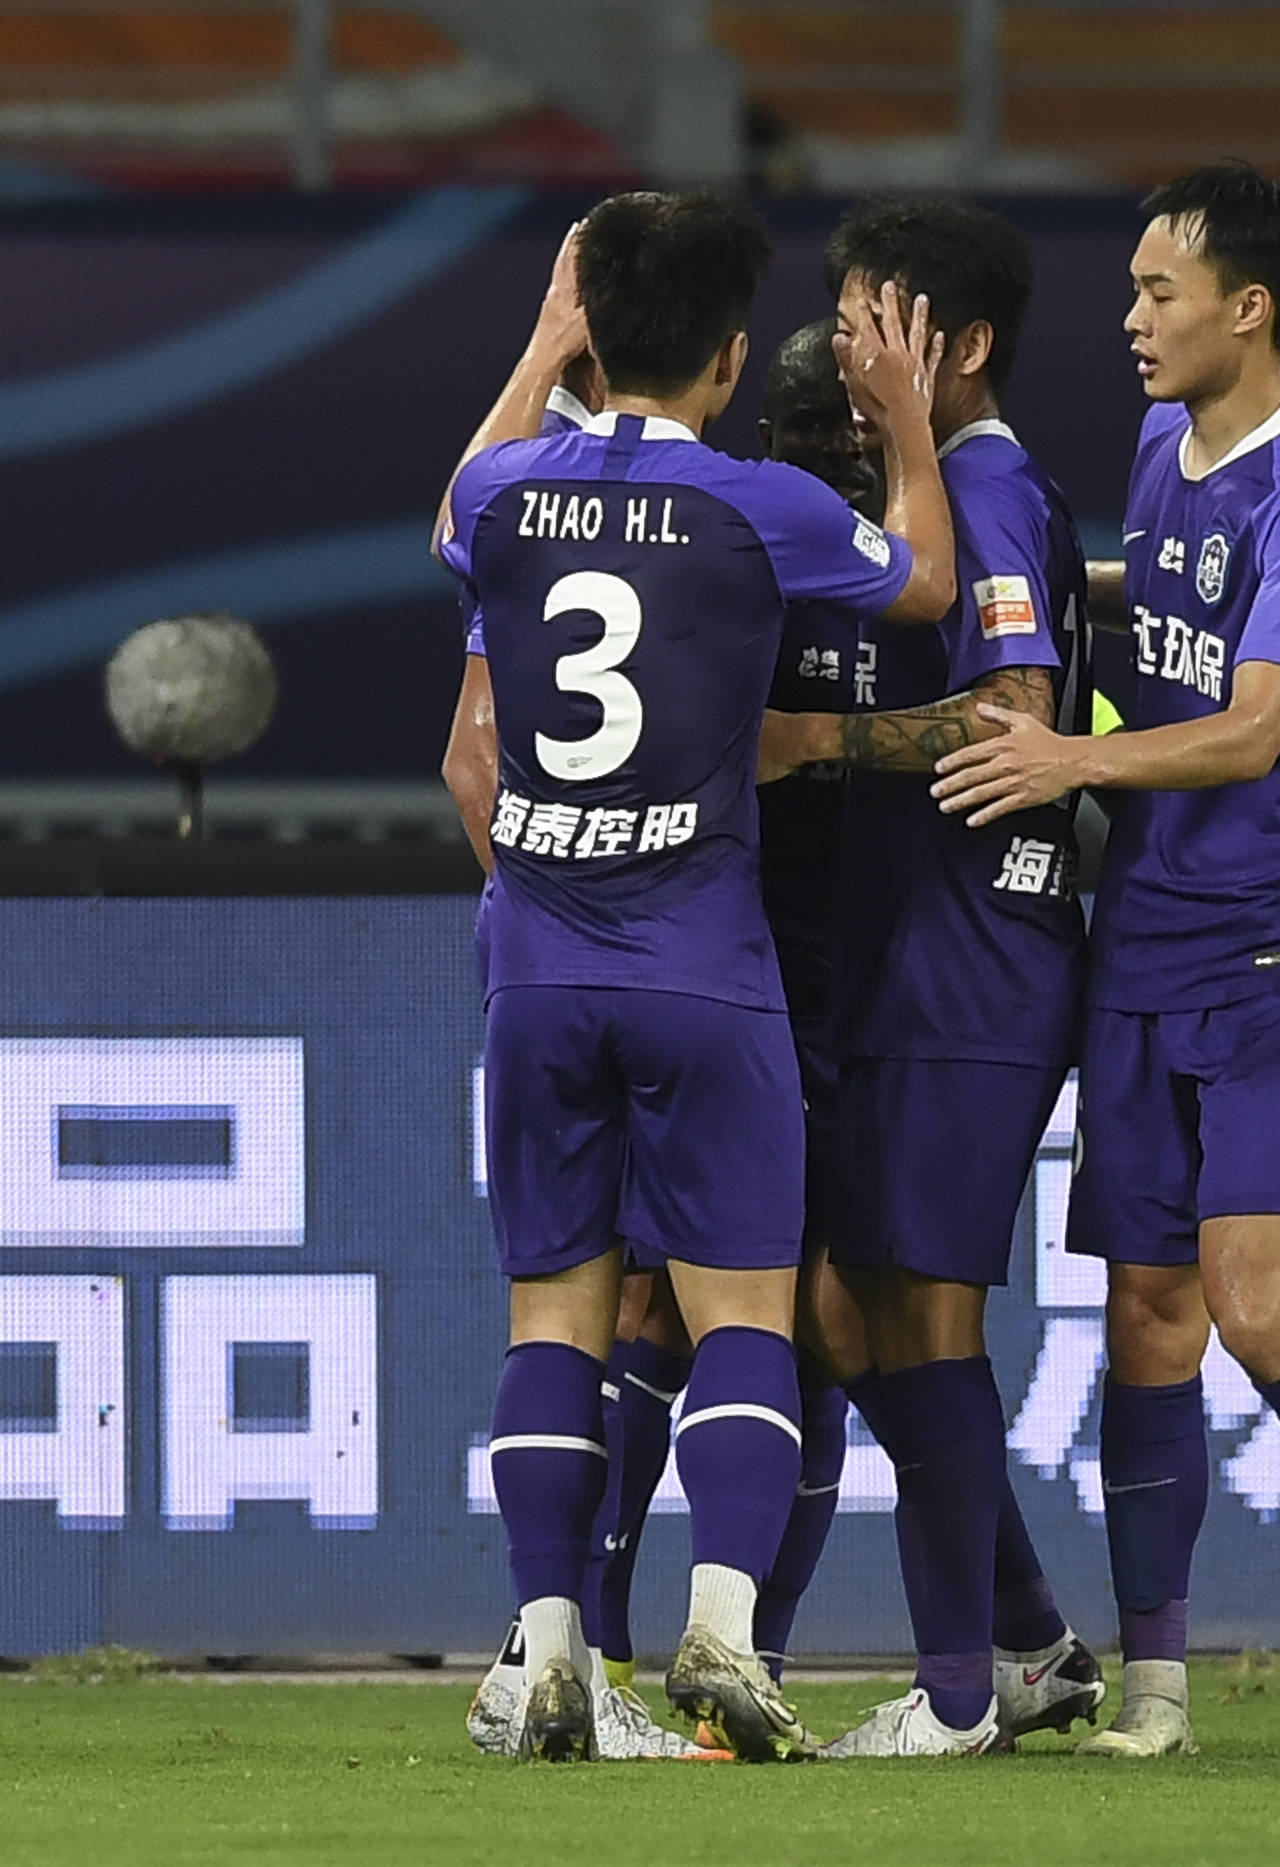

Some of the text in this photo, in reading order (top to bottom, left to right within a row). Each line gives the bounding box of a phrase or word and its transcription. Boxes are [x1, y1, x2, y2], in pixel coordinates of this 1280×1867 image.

[518, 491, 690, 544] ZHAO H.L.
[534, 570, 643, 782] 3
[489, 788, 699, 859] 海泰控股
